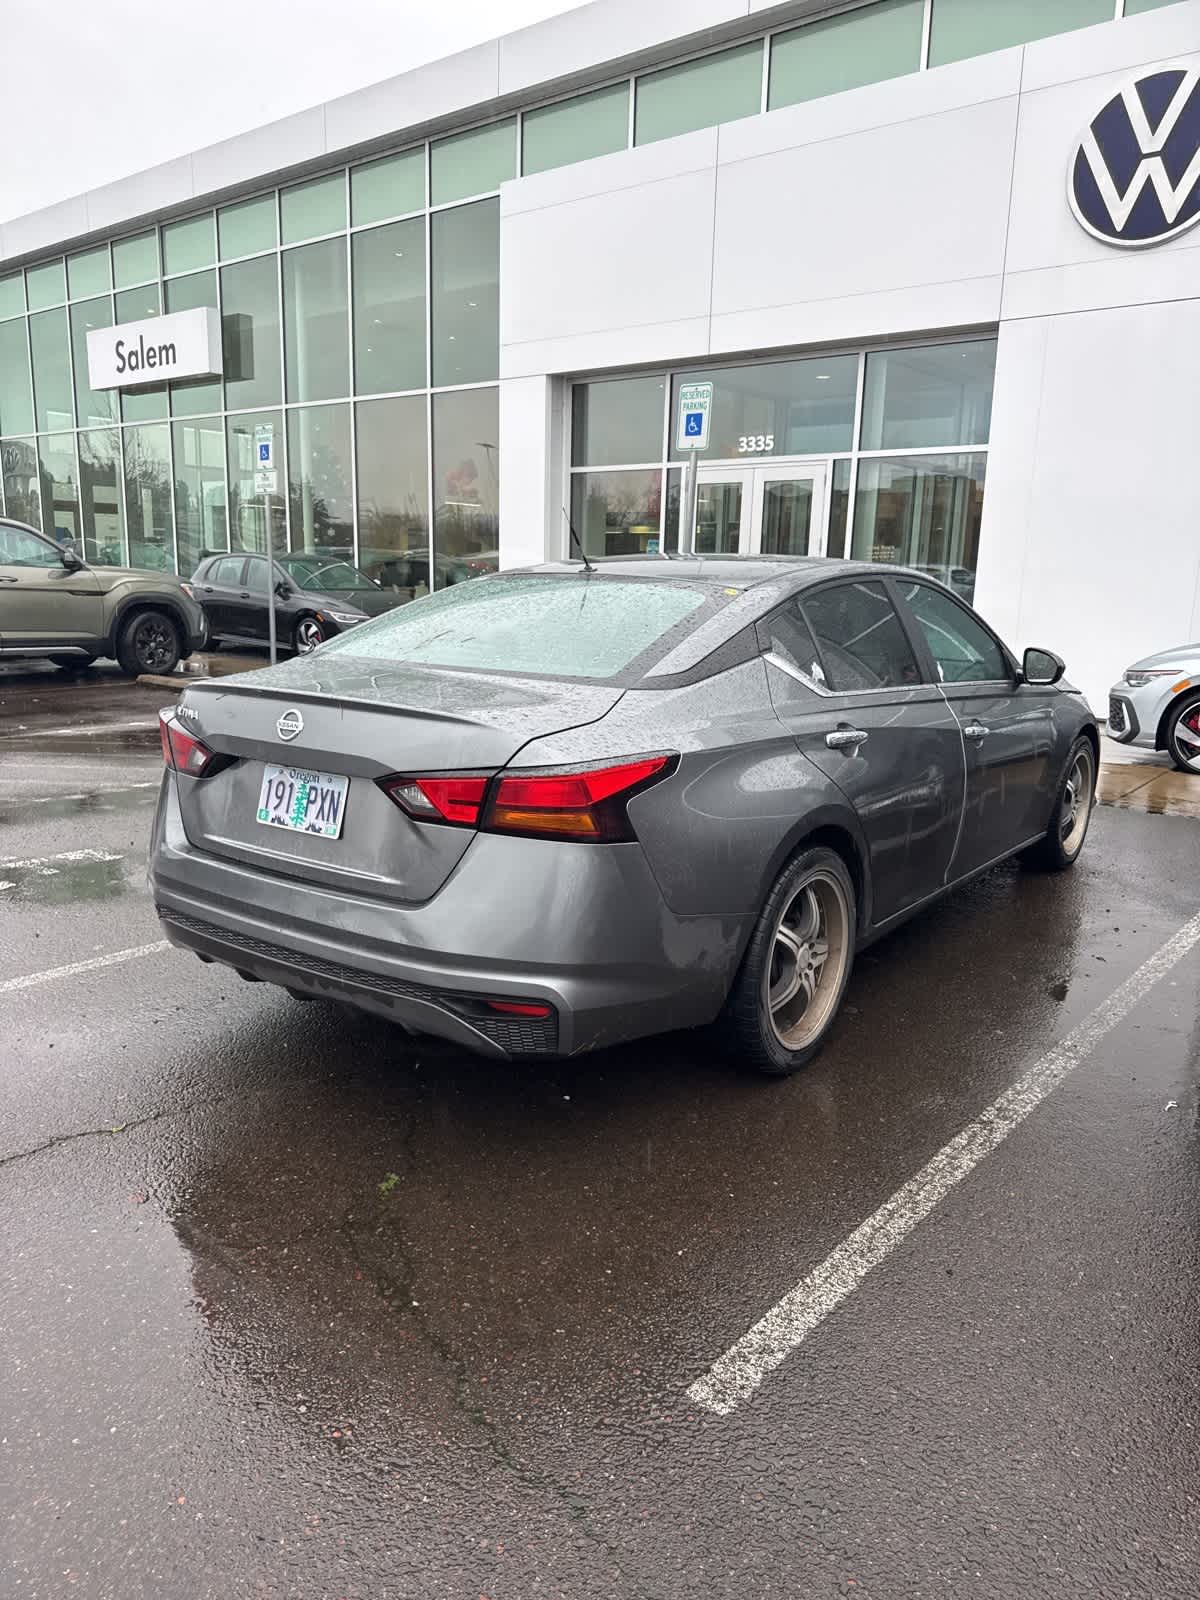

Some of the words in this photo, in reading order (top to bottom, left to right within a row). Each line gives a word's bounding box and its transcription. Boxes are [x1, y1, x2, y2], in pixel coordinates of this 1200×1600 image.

[1076, 66, 1200, 233] VW
[115, 334, 177, 373] Salem
[738, 435, 774, 452] 3335
[289, 769, 320, 784] Oregon
[265, 779, 294, 814] 191
[304, 785, 341, 823] PXN
